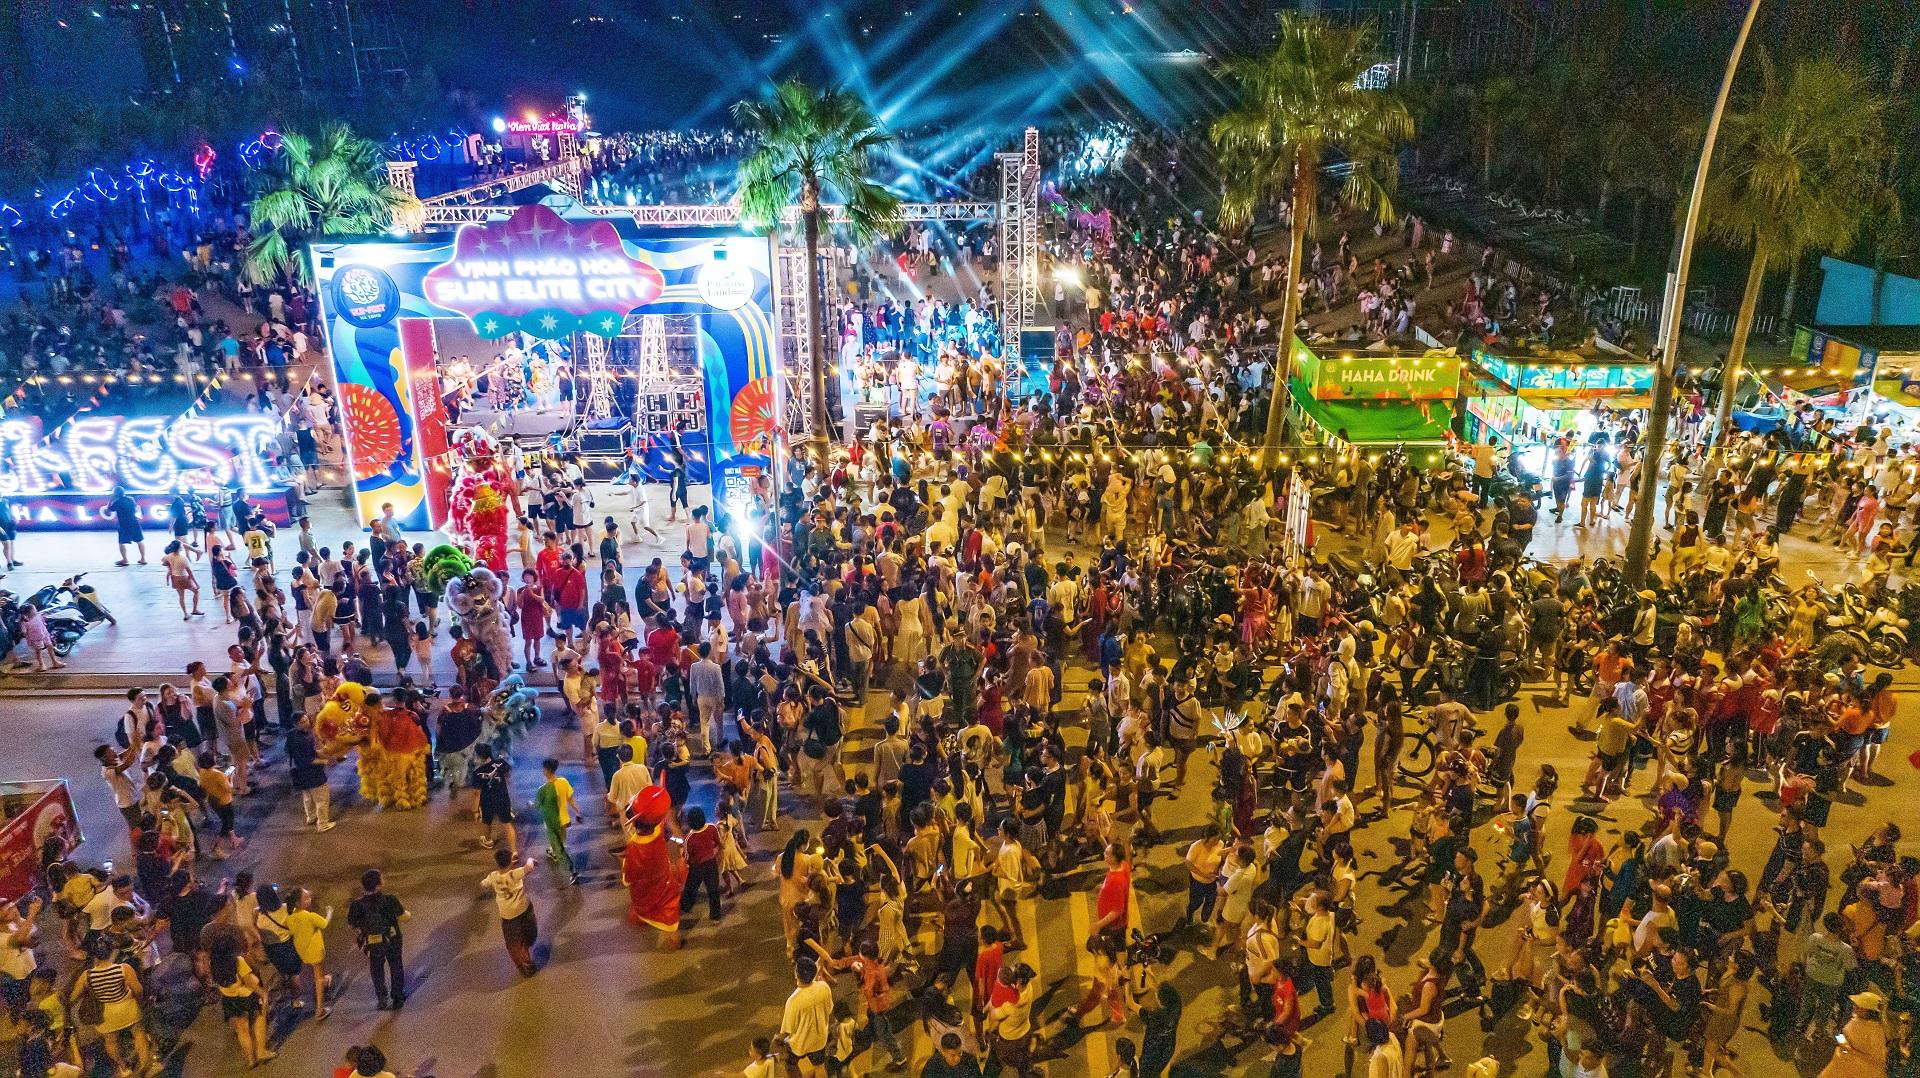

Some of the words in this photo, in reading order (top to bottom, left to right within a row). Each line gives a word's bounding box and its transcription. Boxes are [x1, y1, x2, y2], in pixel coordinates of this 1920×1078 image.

[455, 261, 511, 278] VỊNH
[514, 257, 577, 276] PHÁO
[580, 258, 631, 275] HOA
[435, 280, 500, 301] SUN
[505, 279, 582, 300] ELITE
[586, 278, 650, 299] CITY
[1341, 369, 1385, 383] HAHA
[1388, 368, 1436, 382] DRINK
[11, 504, 58, 522] HA
[252, 539, 261, 549] 21
[1449, 719, 1457, 738] 7
